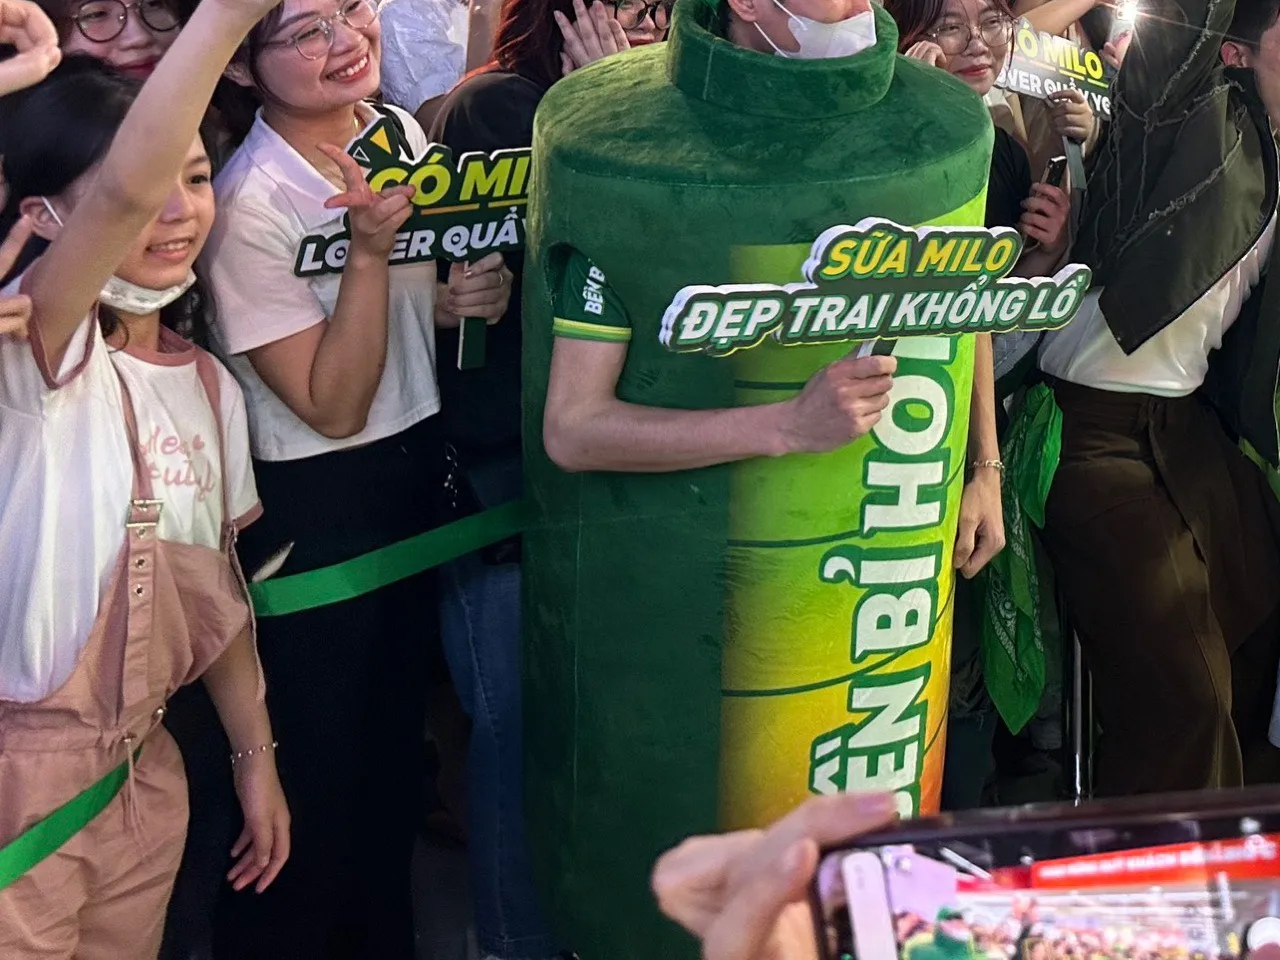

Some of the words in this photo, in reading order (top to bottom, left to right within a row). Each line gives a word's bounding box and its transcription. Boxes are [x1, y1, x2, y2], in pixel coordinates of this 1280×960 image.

[299, 229, 437, 274] LOER
[441, 205, 530, 259] QUẨ
[822, 226, 907, 277] SỮA
[916, 236, 1014, 274] MILO
[677, 294, 787, 351] ĐẸP
[784, 291, 896, 335] TRAI
[894, 274, 1027, 329] KHỔNG
[1027, 272, 1085, 321] LỒ
